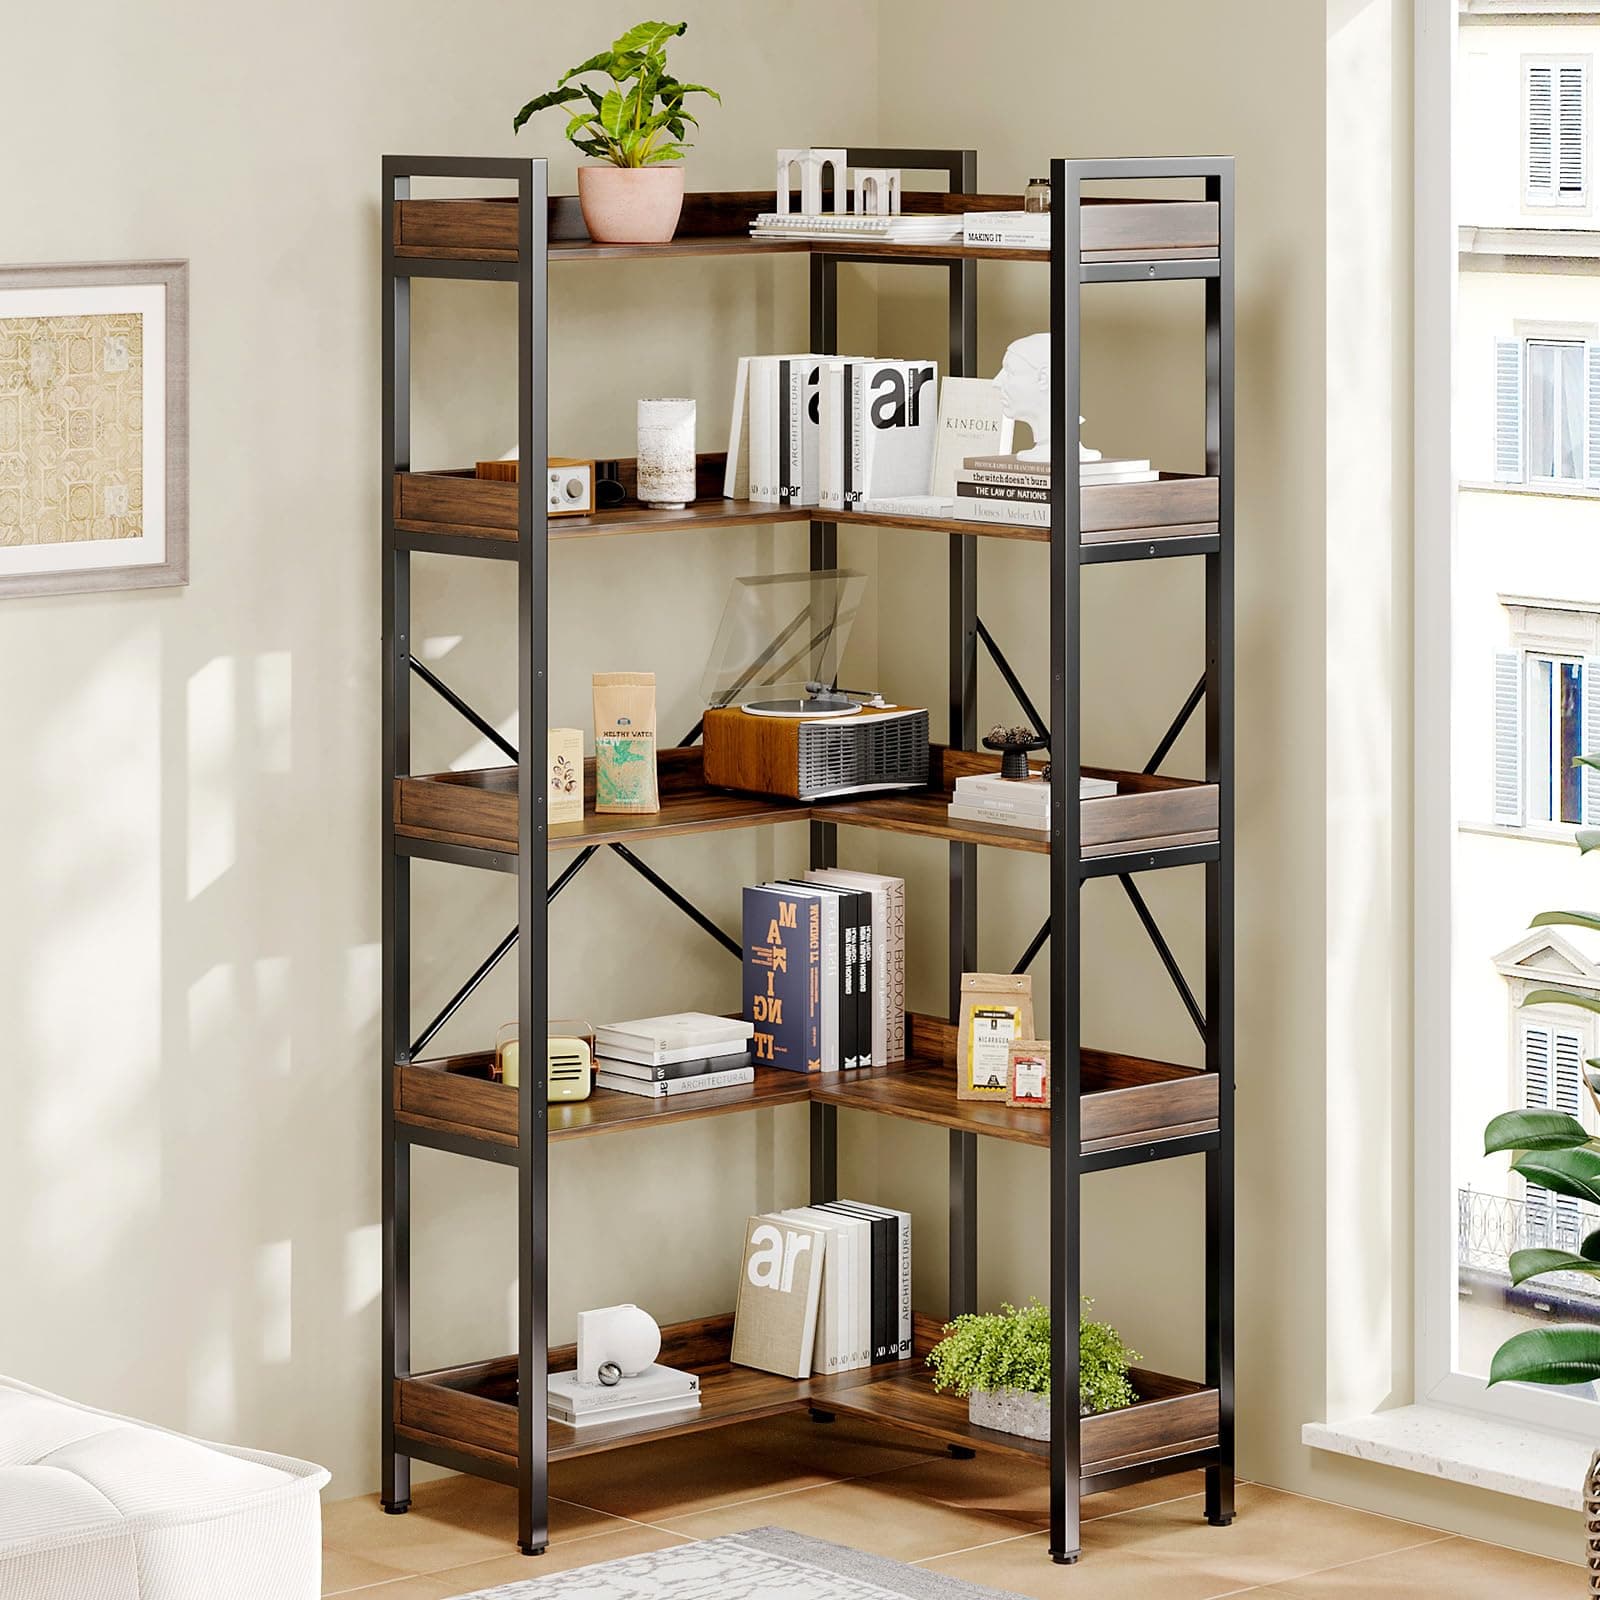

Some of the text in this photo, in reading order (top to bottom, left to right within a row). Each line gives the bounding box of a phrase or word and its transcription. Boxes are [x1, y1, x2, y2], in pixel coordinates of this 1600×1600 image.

[968, 233, 994, 242] MAKING
[995, 233, 1003, 242] IT
[871, 367, 934, 430] ar
[791, 372, 800, 468] ARCHITECTURAL
[854, 376, 862, 472] ARCHITECTURAL
[946, 417, 998, 432] KINFOLK
[973, 473, 1048, 487] the witch doesn't burn
[789, 485, 801, 497] ar
[852, 490, 863, 502] ar
[975, 486, 1047, 501] THE LAW OF NATIONS
[681, 1072, 748, 1090] ARCHITECTURAL
[747, 1224, 811, 1293] ar
[902, 1224, 910, 1321] ARCHITECTURAL
[899, 1339, 912, 1352] ar
